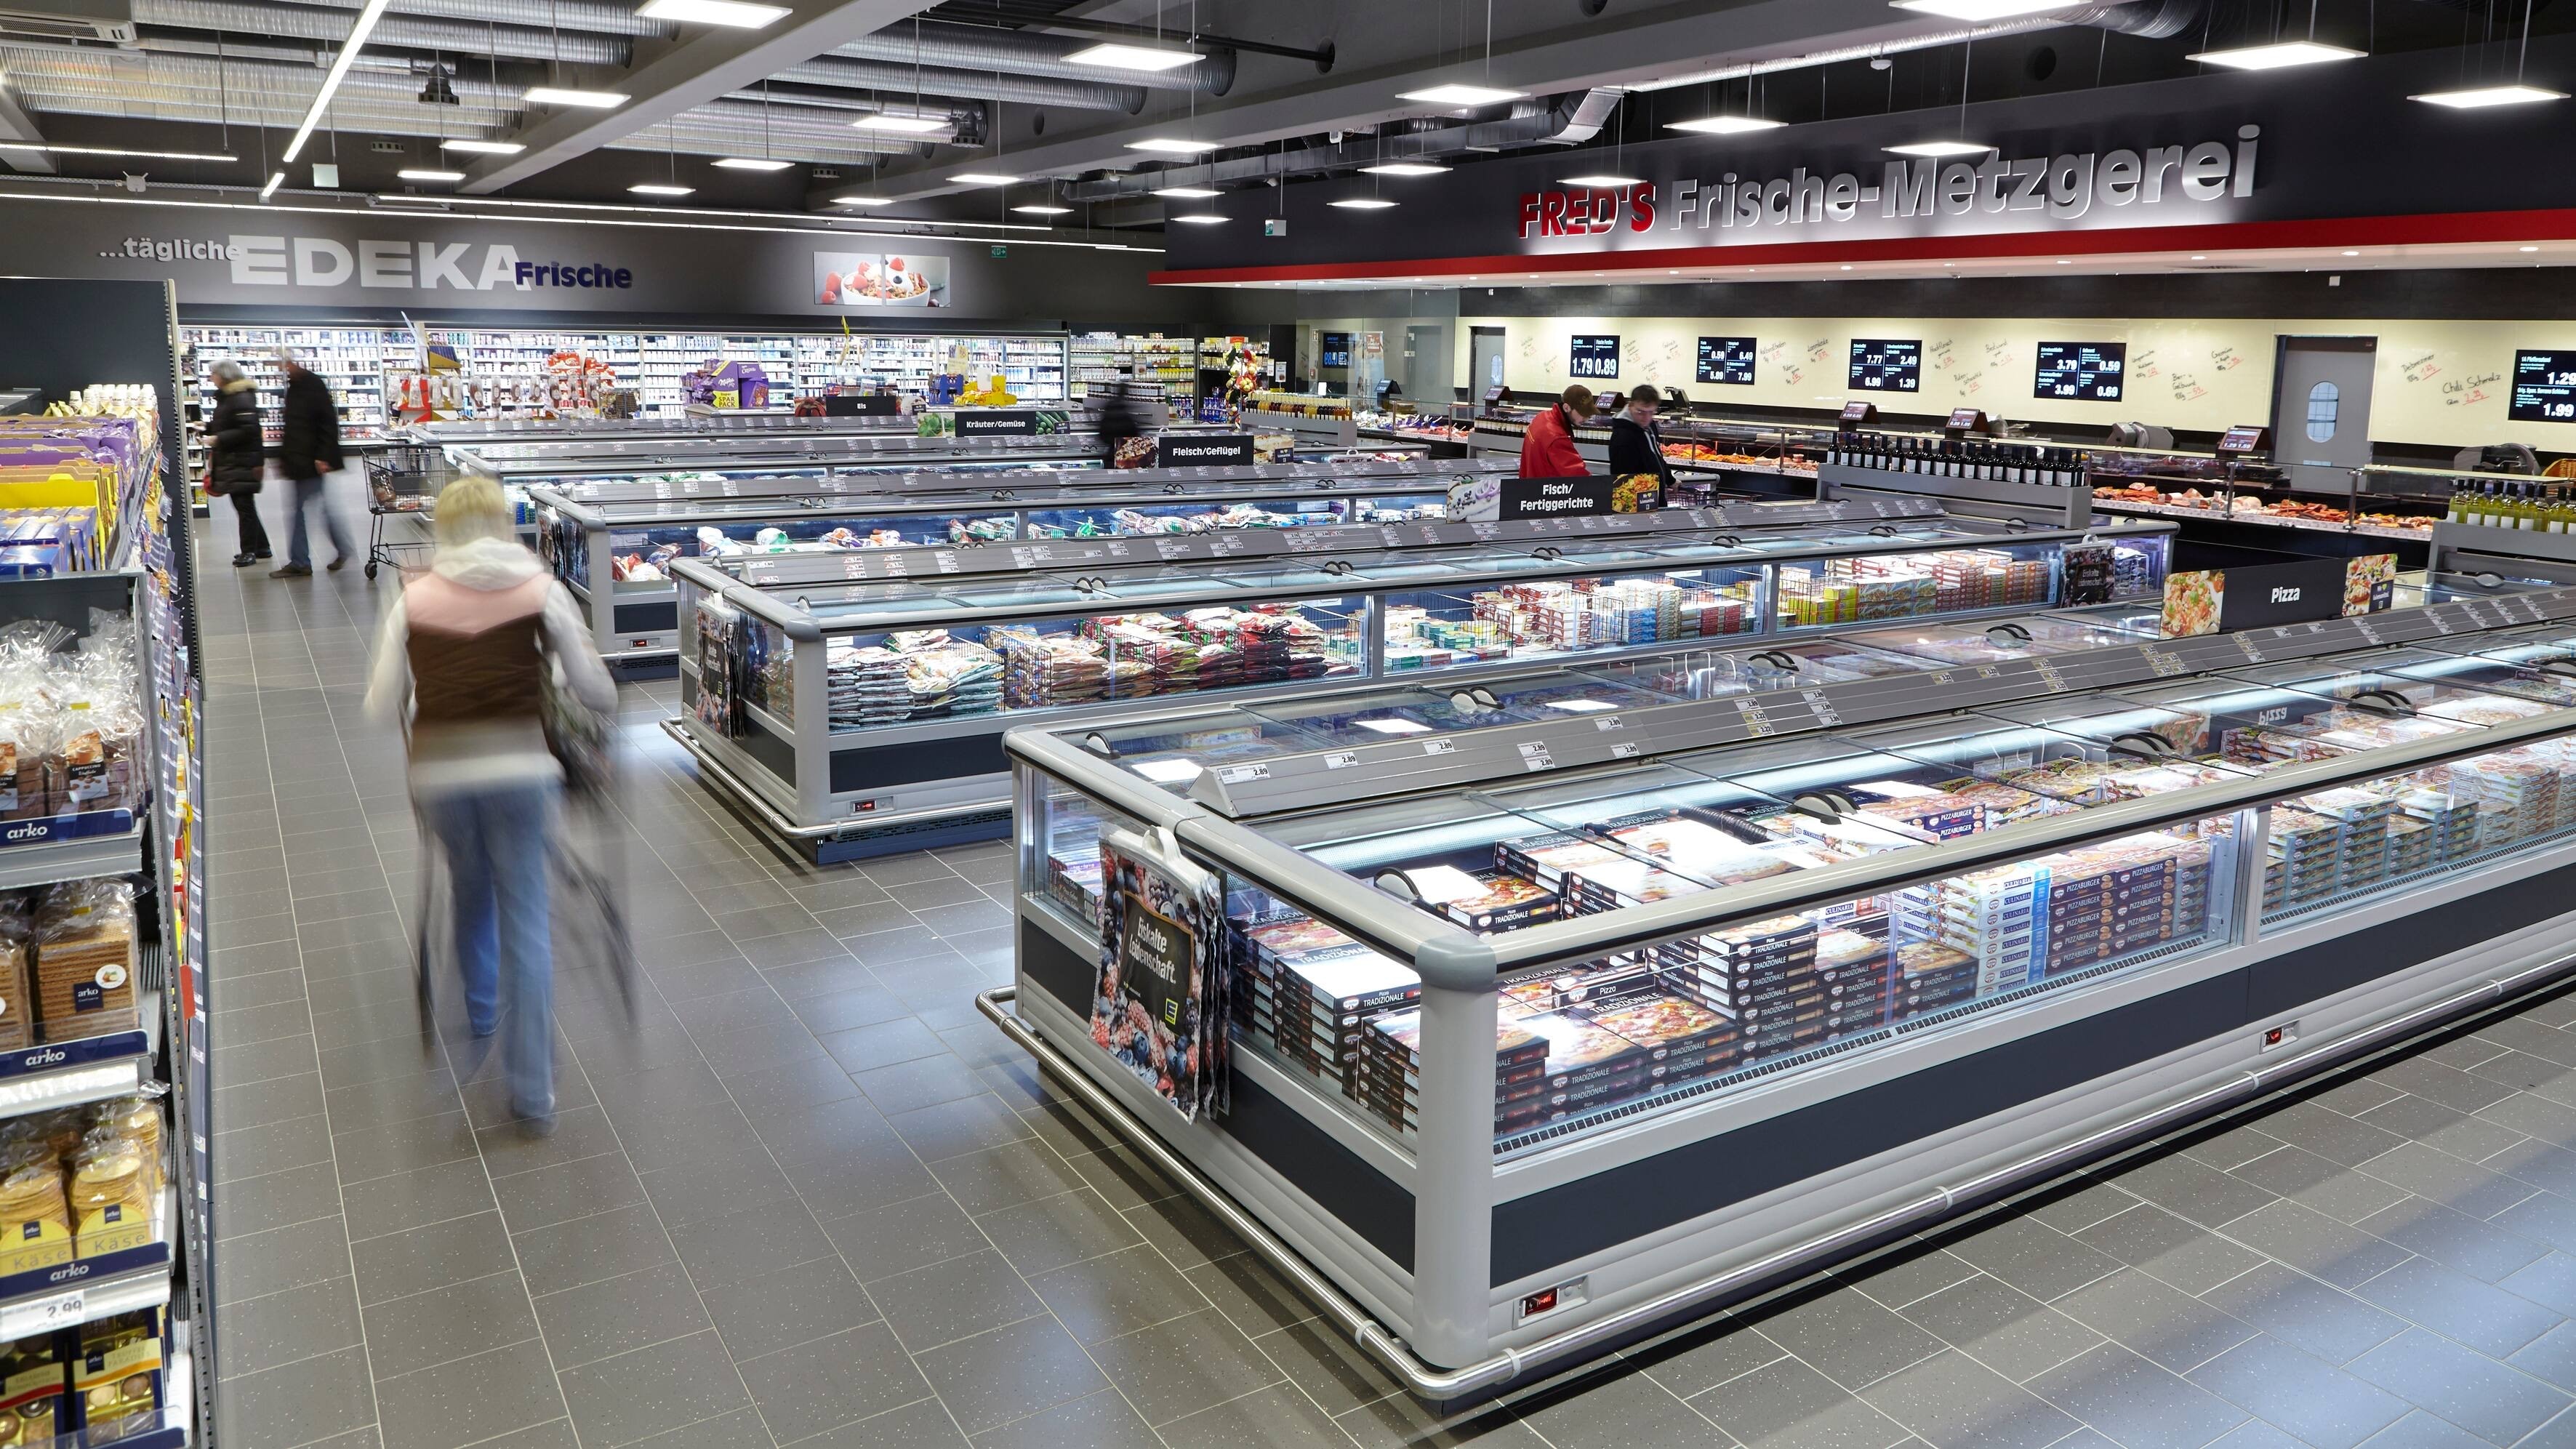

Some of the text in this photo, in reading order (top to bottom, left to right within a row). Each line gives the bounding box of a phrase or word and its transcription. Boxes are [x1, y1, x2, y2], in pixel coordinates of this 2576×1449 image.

[1518, 124, 2262, 239] FRED'S Frische-Metzgerei
[100, 237, 241, 262] ...tägliche
[229, 234, 531, 292] EDEKA
[515, 261, 634, 289] Frische
[1573, 357, 1593, 374] 1.79
[1594, 358, 1617, 375] 0.89
[1866, 355, 1883, 364] 7.77
[1900, 356, 1917, 365] 2.49
[1899, 378, 1916, 388] 1.39
[2442, 372, 2501, 393] Chili Schmalz
[2548, 372, 2576, 385] 1.29
[2543, 403, 2575, 417] 1.99
[966, 420, 1026, 429] Kräuter/Gemüse
[1173, 446, 1241, 457] Fleisch/Geflügel
[1542, 483, 1573, 495] Fisch/
[1520, 497, 1594, 511] Fertiggerichte
[2271, 586, 2300, 603] Pizza
[1439, 742, 1453, 750] 2.89
[1253, 768, 1268, 776] 2.89
[1605, 811, 1666, 828] TRADIZIONALE
[1941, 808, 1972, 821] PIZZABURGER
[7, 823, 48, 840] arko
[1941, 824, 1972, 836] PIZZABURGER
[2132, 862, 2164, 877] PIZZABURGER
[2066, 878, 2100, 893] PIZZABURGER
[2131, 879, 2162, 894] PIZZABURGER
[1903, 893, 1928, 905] CULINARIA
[2004, 892, 2031, 905] CULINARIA
[2067, 895, 2100, 910] PIZZABURGER
[2130, 895, 2161, 910] PIZZABURGER
[1826, 902, 1854, 915] CULINARIA
[2003, 907, 2030, 920] CULINARIA
[1495, 910, 1528, 924] TRADIZIONALE
[2066, 912, 2100, 928] PIZZABURGER
[2127, 912, 2160, 926] PIZZABURGER
[1903, 921, 1929, 935] CULINARIA
[2003, 920, 2030, 934] CULINARIA
[1137, 916, 1168, 953] Eiskalte
[2065, 930, 2098, 944] PIZZABURGER
[2127, 928, 2159, 943] PIZZABURGER
[2002, 936, 2029, 949] CULINARIA
[1128, 934, 1176, 984] Leidenschaft.
[1297, 947, 1373, 964] TRADIZIONAL
[2002, 950, 2029, 963] CULINARIA
[2063, 947, 2097, 962] PIZZABURGER
[1753, 956, 1786, 971] TRADIZIONALE
[1839, 965, 1869, 979] TRADIZIONALE
[2000, 965, 2027, 978] CULINARIA
[1752, 972, 1785, 987] TRADIZIONALE
[1846, 979, 1877, 993] TRADIZIONALE
[78, 988, 99, 998] arko
[1600, 985, 1616, 995] Pizza
[1754, 989, 1786, 1003] TRADIZIONALE
[1363, 992, 1404, 1007] TRADIZIONALE
[1590, 992, 1663, 1014] TRADIZIONALE
[1845, 995, 1876, 1008] TRADIZIONALE
[1761, 1002, 1794, 1016] TRADIZIONALE
[1844, 1010, 1874, 1024] TRADIZIONALE
[1762, 1018, 1794, 1032] TRADIZIONALE
[1760, 1034, 1791, 1048] TRADIZIONALE
[1671, 1041, 1706, 1056] TRADIZIONALE
[25, 1049, 65, 1067] arko
[1669, 1058, 1704, 1074] TRADIZIONALE
[1572, 1067, 1610, 1085] TRADIZIONALE
[1570, 1085, 1608, 1101] TRADIZIONALE
[95, 1234, 145, 1253] Käse
[15, 1250, 67, 1269] Käse
[50, 1263, 89, 1281] arko
[47, 1301, 82, 1319] 2.99
